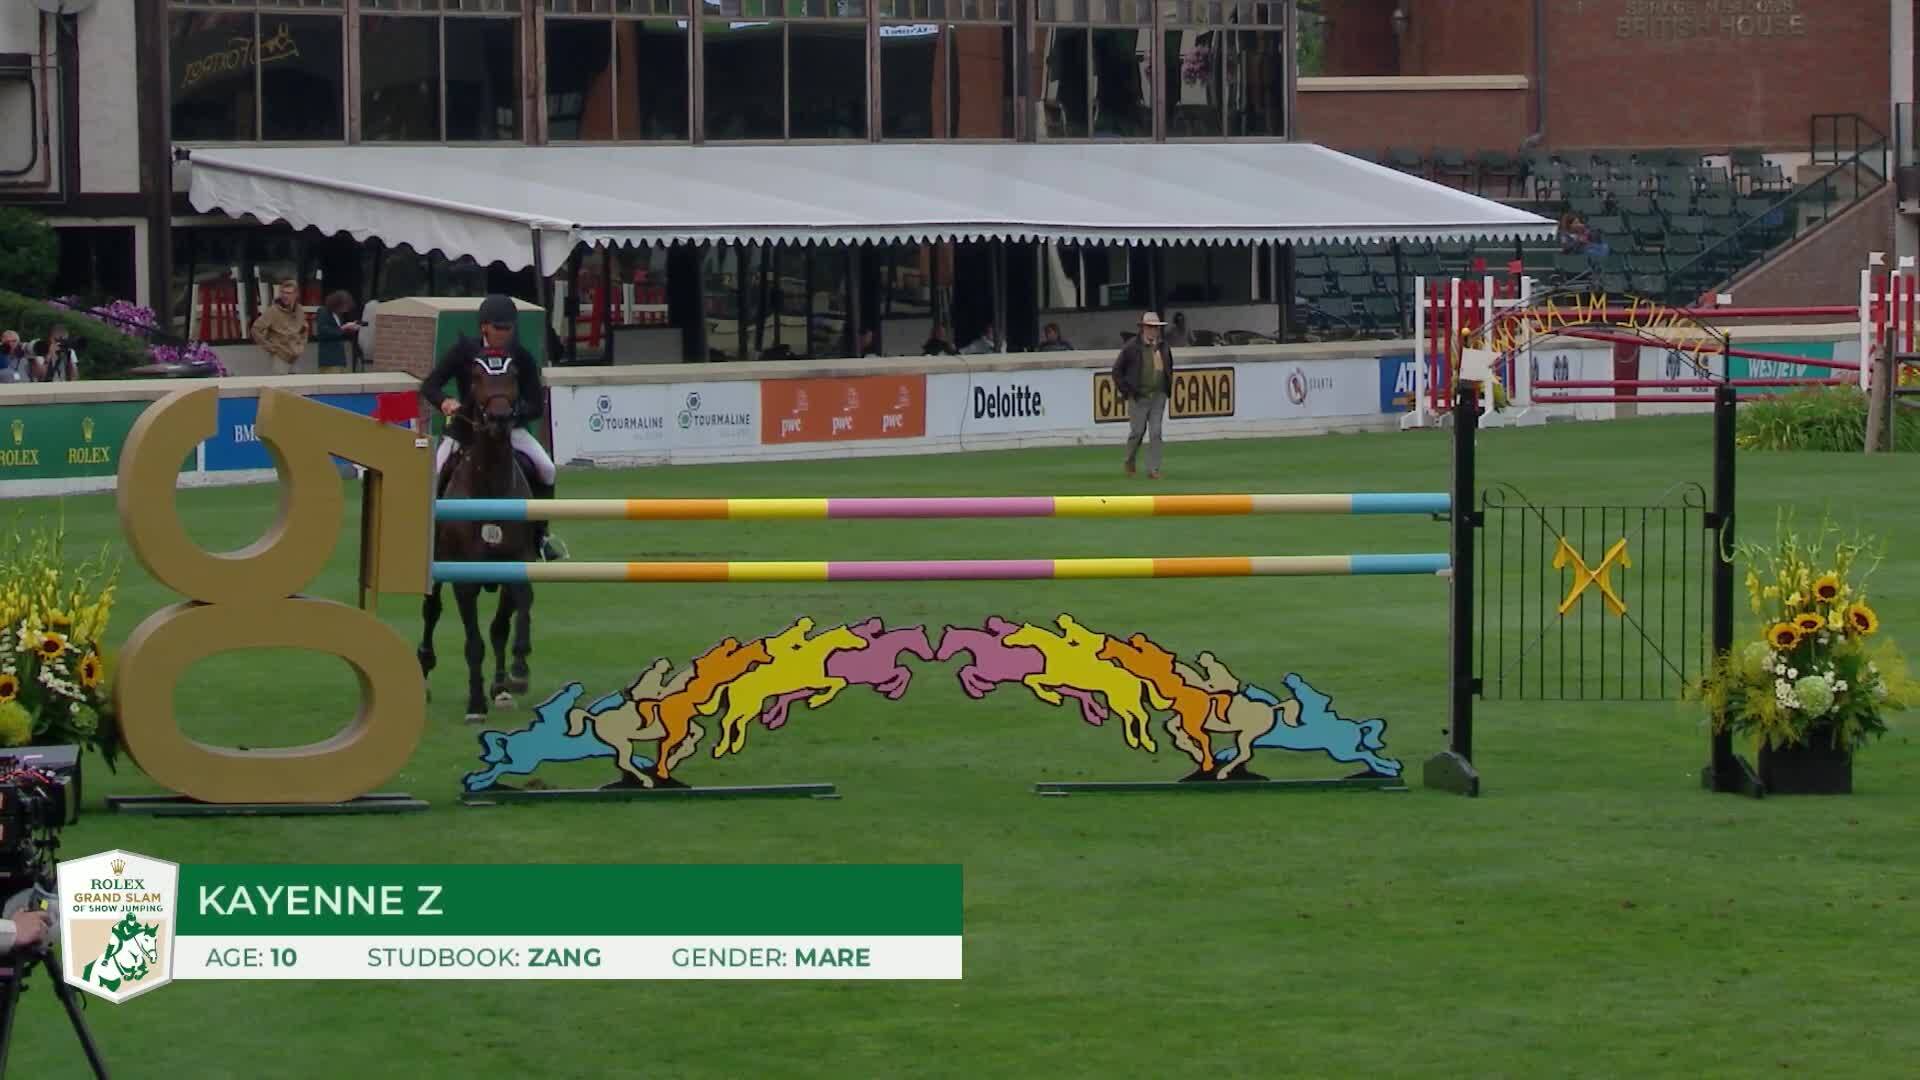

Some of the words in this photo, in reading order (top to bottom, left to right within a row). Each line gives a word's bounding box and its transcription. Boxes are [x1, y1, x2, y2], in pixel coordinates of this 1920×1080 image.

[1616, 15, 1713, 39] BRITISH
[1719, 14, 1807, 37] HOUSE
[1174, 374, 1231, 413] CANA
[605, 416, 664, 430] TOURMALINE
[694, 413, 751, 426] TOURMALINE
[781, 418, 801, 437] pwc
[832, 416, 853, 435] pwc
[882, 413, 903, 432] pwc
[0, 449, 40, 467] ROLEX
[68, 446, 111, 465] ROLEX
